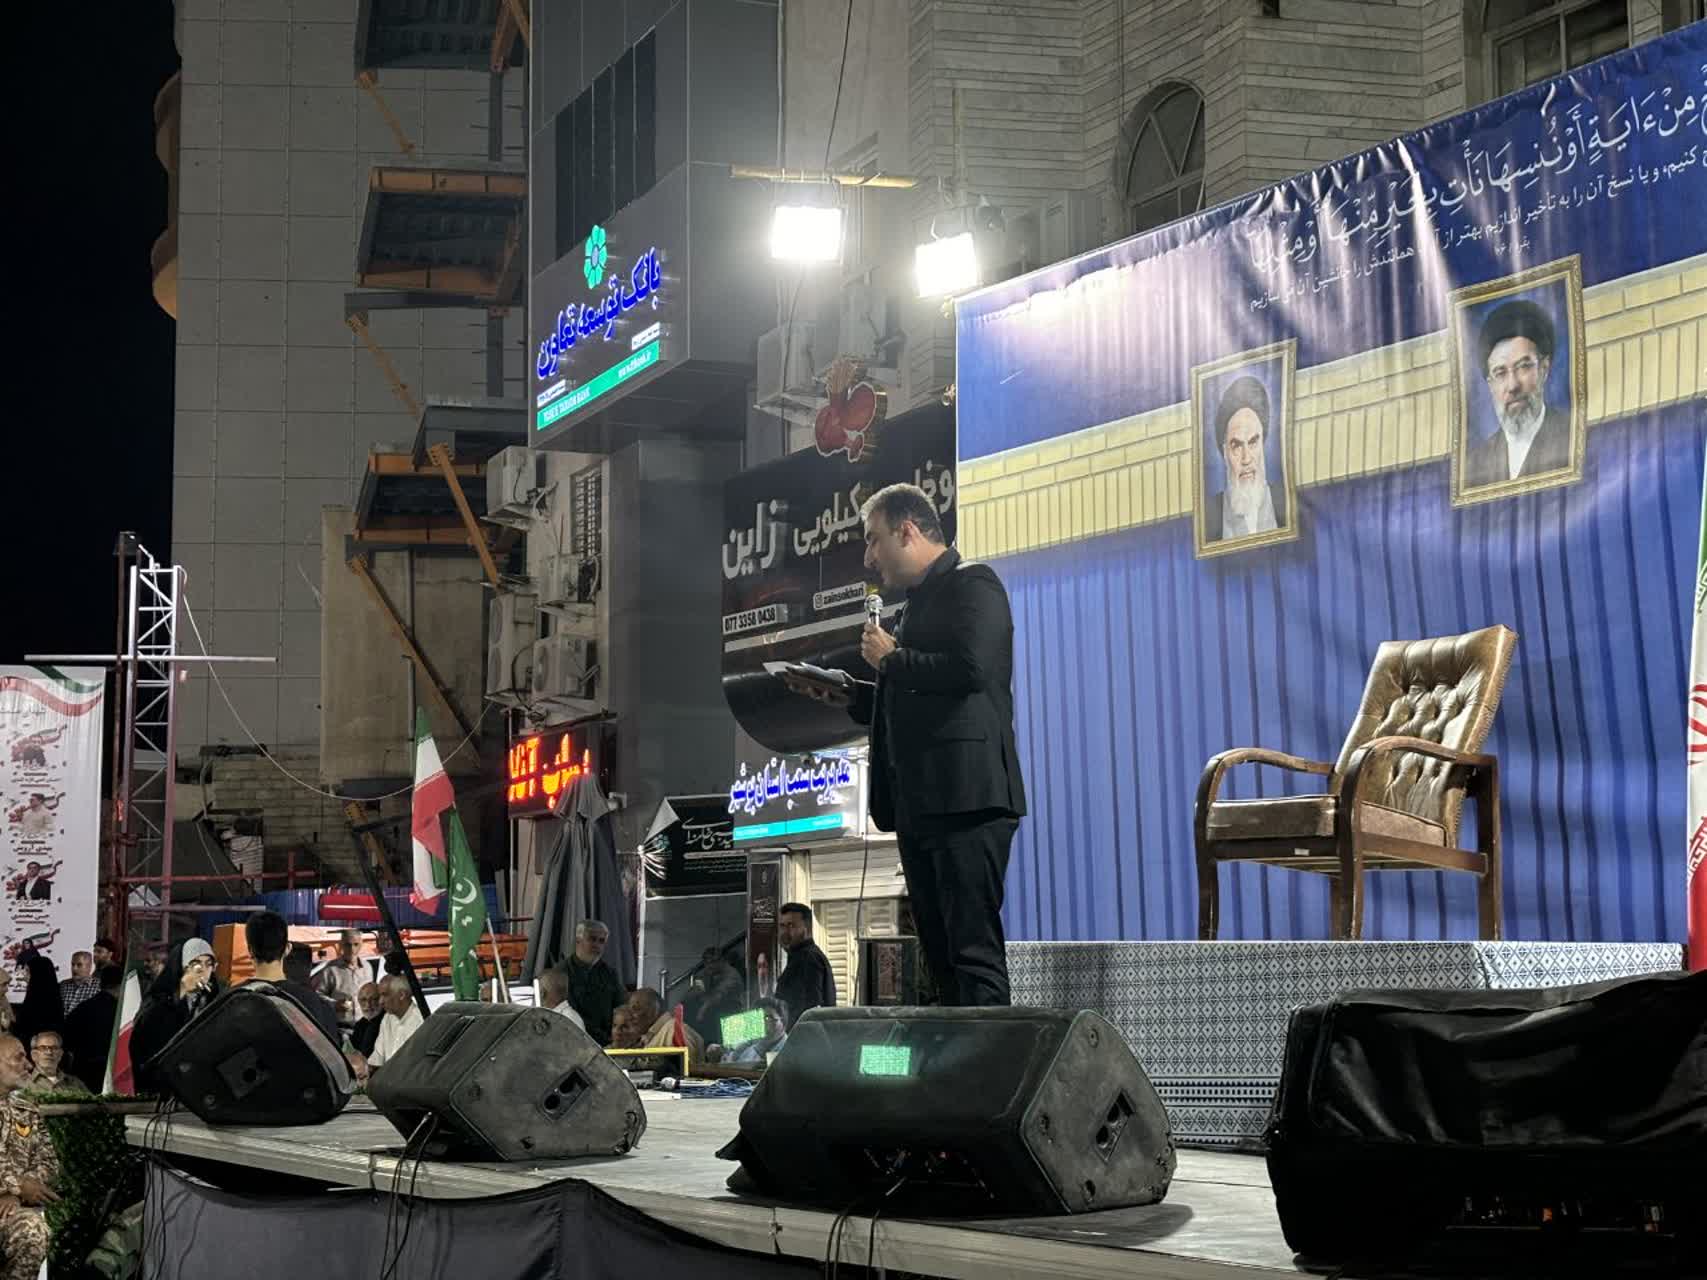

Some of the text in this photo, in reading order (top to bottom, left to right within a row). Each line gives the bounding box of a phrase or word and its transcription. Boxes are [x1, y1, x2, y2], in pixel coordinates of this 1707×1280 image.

[1558, 193, 1570, 209] به
[1573, 186, 1584, 208] را
[1586, 174, 1605, 201] آن
[1607, 167, 1635, 198] نسخ
[1442, 228, 1454, 249] از
[1455, 223, 1483, 247] بهتر
[621, 247, 661, 311] بانک
[576, 274, 620, 341] توسعه
[537, 303, 577, 380] تعاون
[722, 499, 780, 580] زاین
[794, 482, 861, 556] کیلویی
[724, 616, 738, 632] 077
[728, 762, 756, 816] بوشهر
[755, 757, 786, 808] استان
